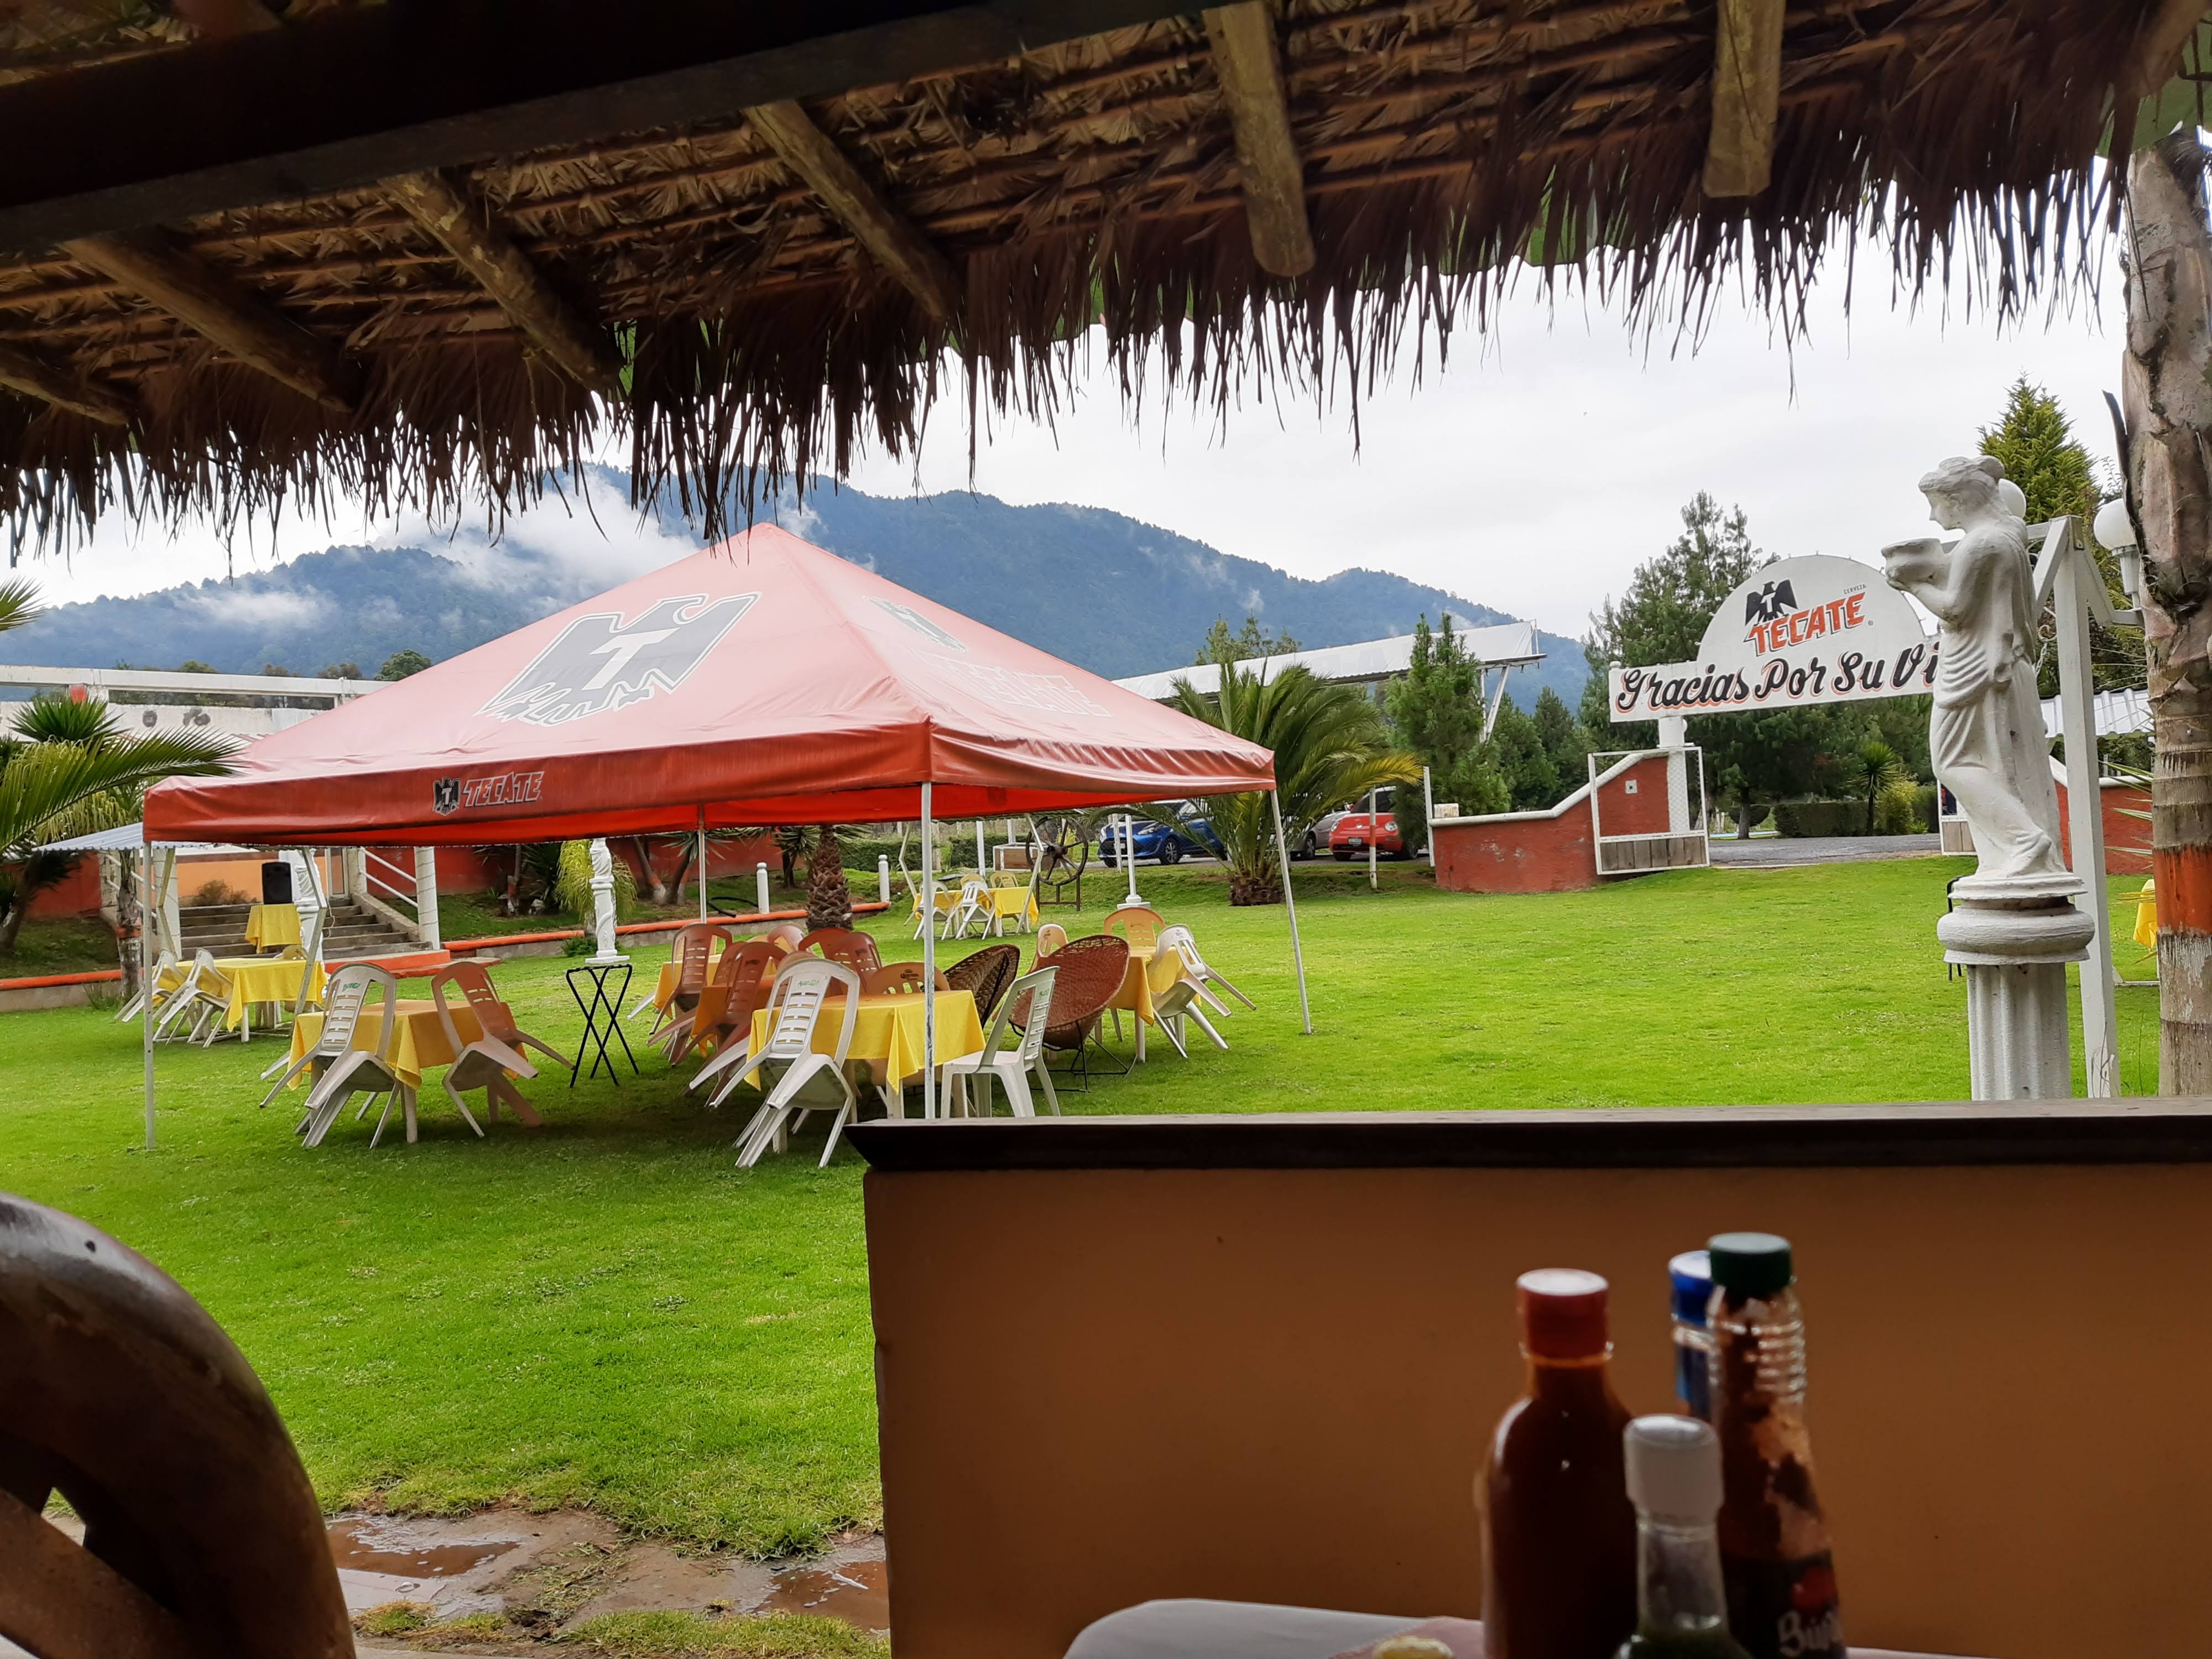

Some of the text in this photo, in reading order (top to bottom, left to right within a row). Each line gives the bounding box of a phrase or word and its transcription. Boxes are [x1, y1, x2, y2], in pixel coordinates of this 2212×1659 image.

[1843, 583, 1866, 594] CERVEZA
[1744, 591, 1866, 656] TECATE
[1616, 641, 1940, 713] Gracias Por Su Vi
[462, 771, 545, 807] TECATE
